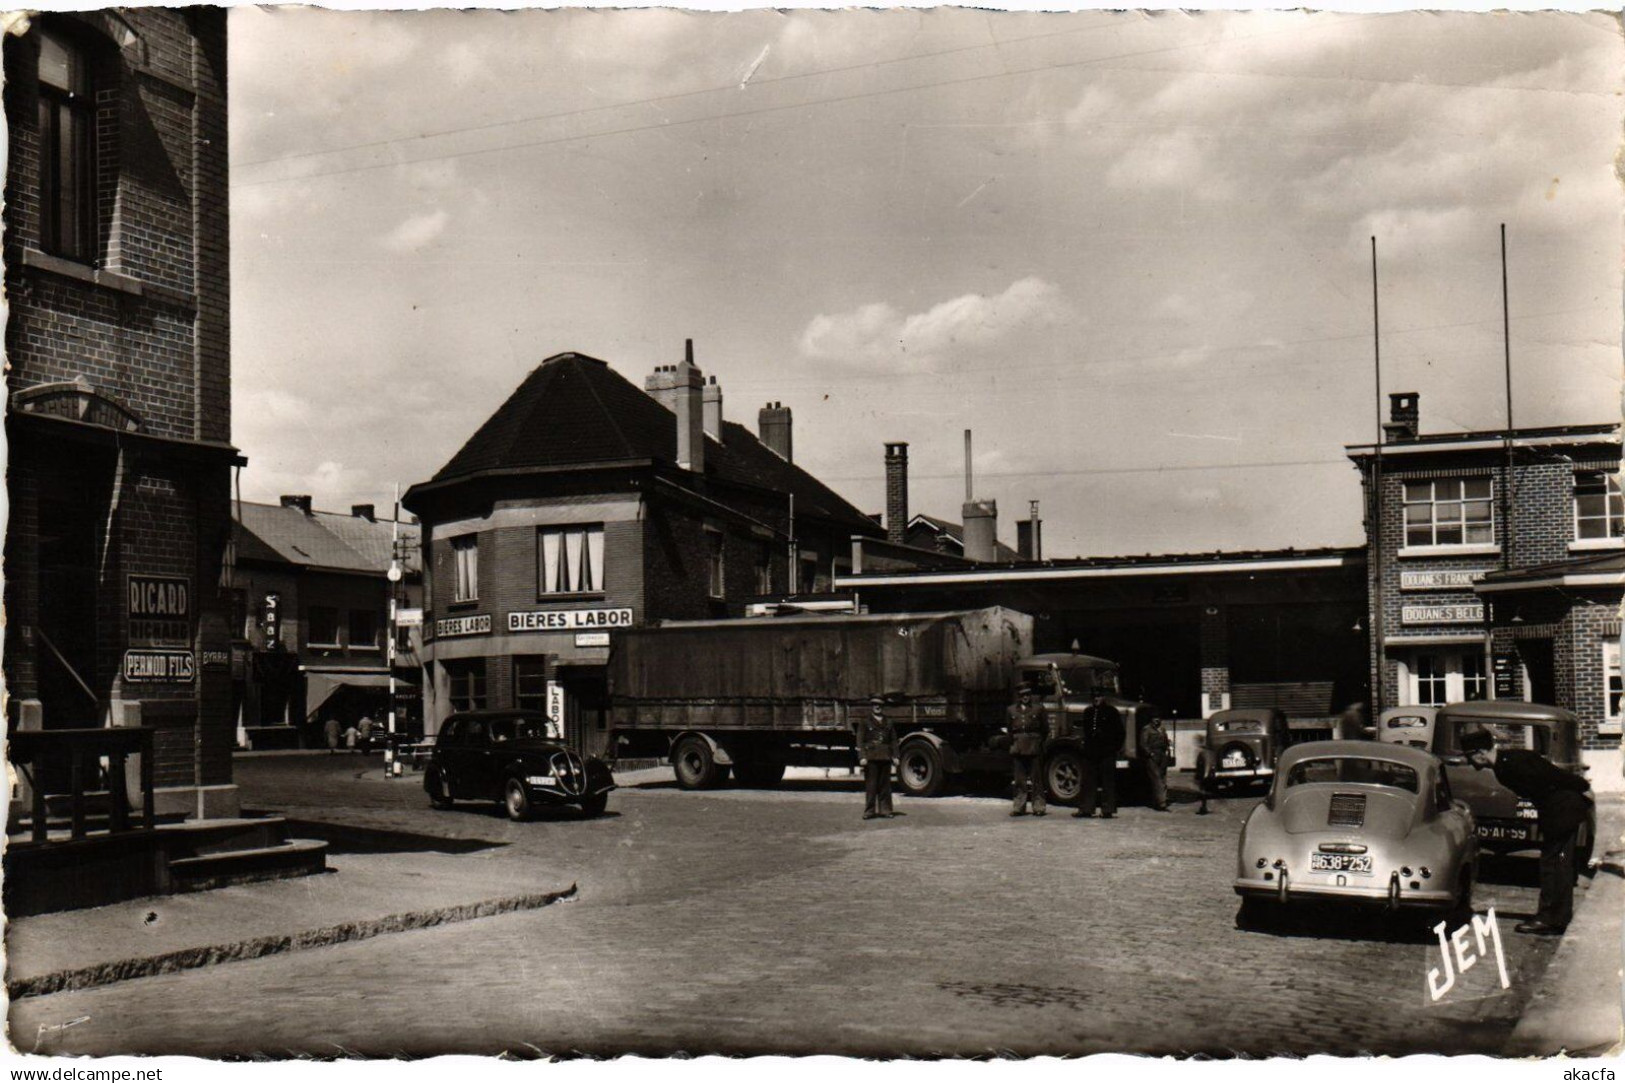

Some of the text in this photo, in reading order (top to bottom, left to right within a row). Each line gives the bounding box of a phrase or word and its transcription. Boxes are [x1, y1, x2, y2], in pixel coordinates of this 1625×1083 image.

[1404, 574, 1443, 586] DOUANES
[130, 581, 187, 615] RICARD
[575, 611, 631, 626] LABOR
[1406, 607, 1484, 620] DOUANES BELG
[464, 616, 491, 632] LABOR
[126, 654, 192, 677] PERNOD FILS
[1336, 874, 1347, 887] D
